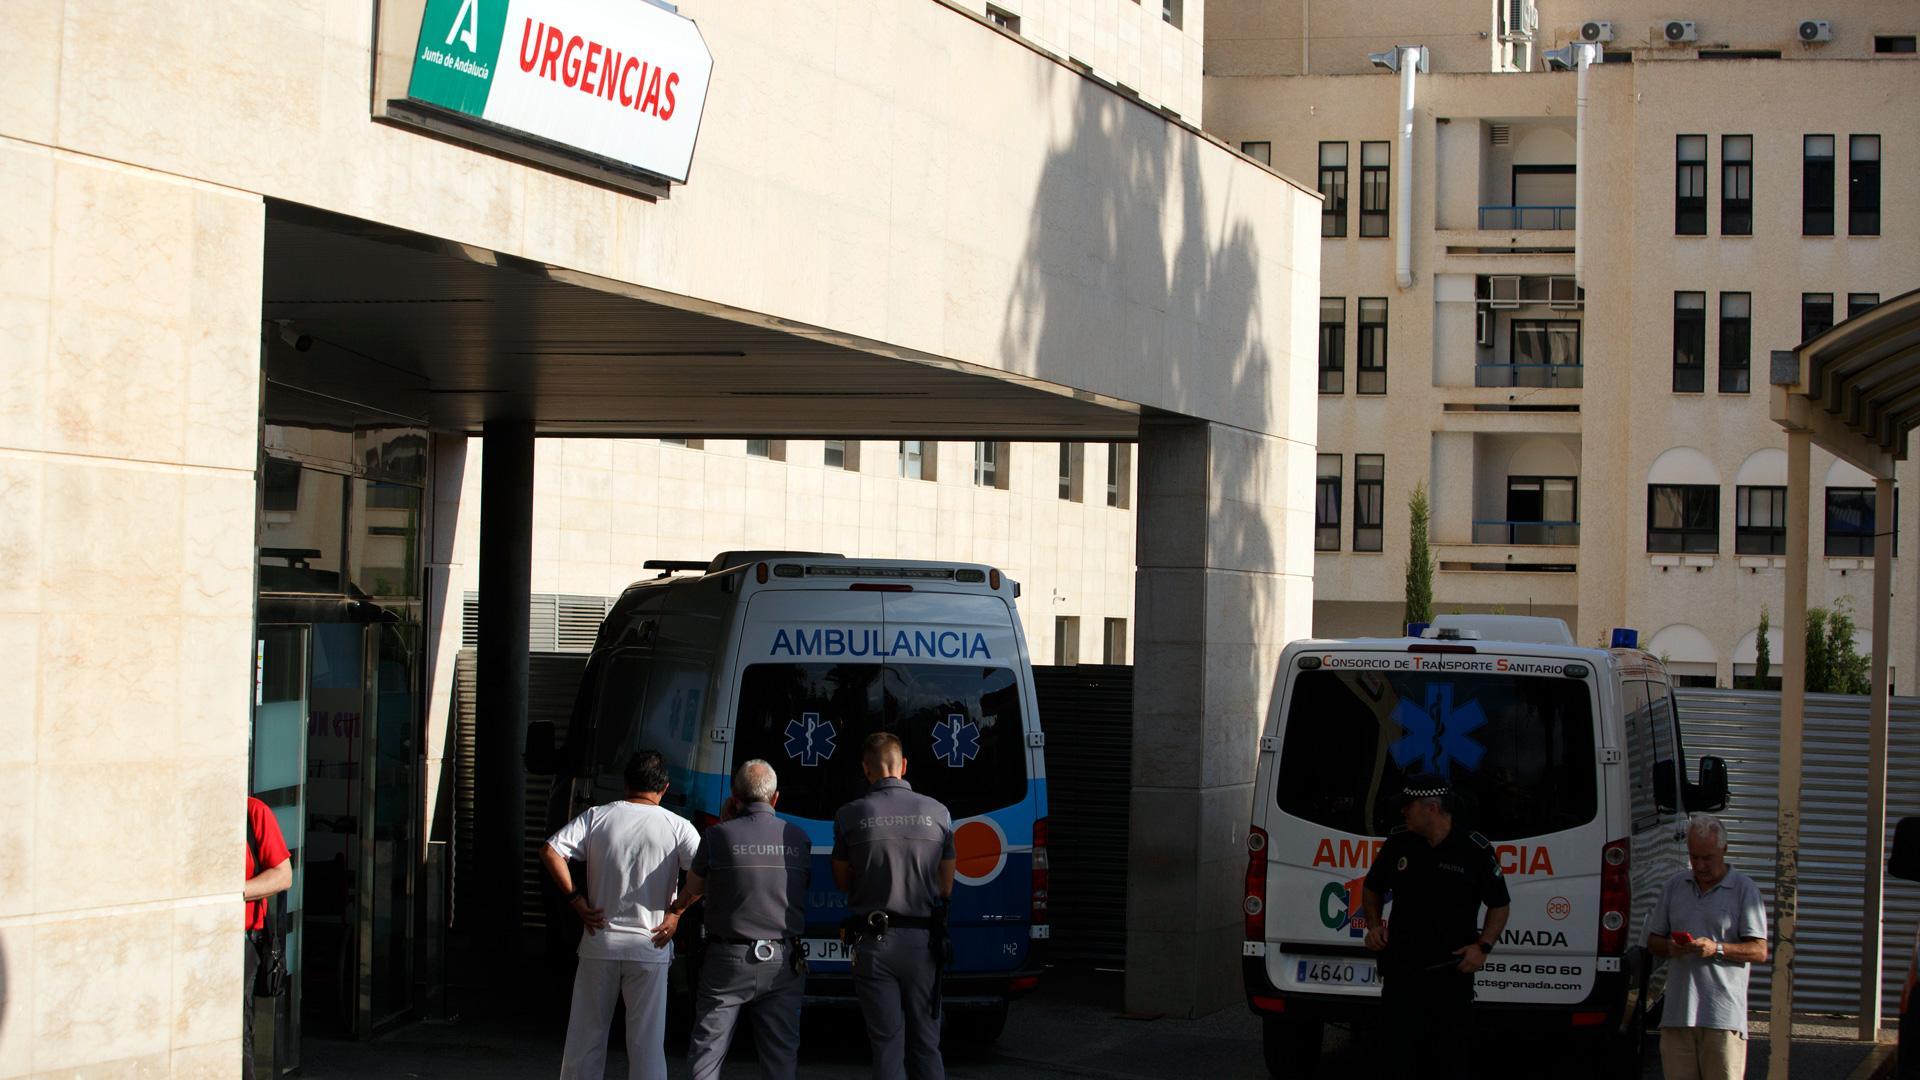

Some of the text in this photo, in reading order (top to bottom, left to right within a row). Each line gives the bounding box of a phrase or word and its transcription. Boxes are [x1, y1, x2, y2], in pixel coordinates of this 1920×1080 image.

[421, 46, 489, 79] Junta de Andalucía
[519, 17, 680, 121] URGENCIAS
[769, 628, 992, 659] AMBULANCIA
[1322, 655, 1563, 674] CONSORCIO DE TRANSPORTE SANITARIO
[859, 815, 933, 830] SECURITAS
[732, 844, 800, 858] SECURITAS
[1548, 902, 1570, 915] 280
[1309, 963, 1354, 982] 4640
[1509, 963, 1531, 974] 40
[1535, 964, 1557, 975] 60
[1560, 966, 1582, 976] 60
